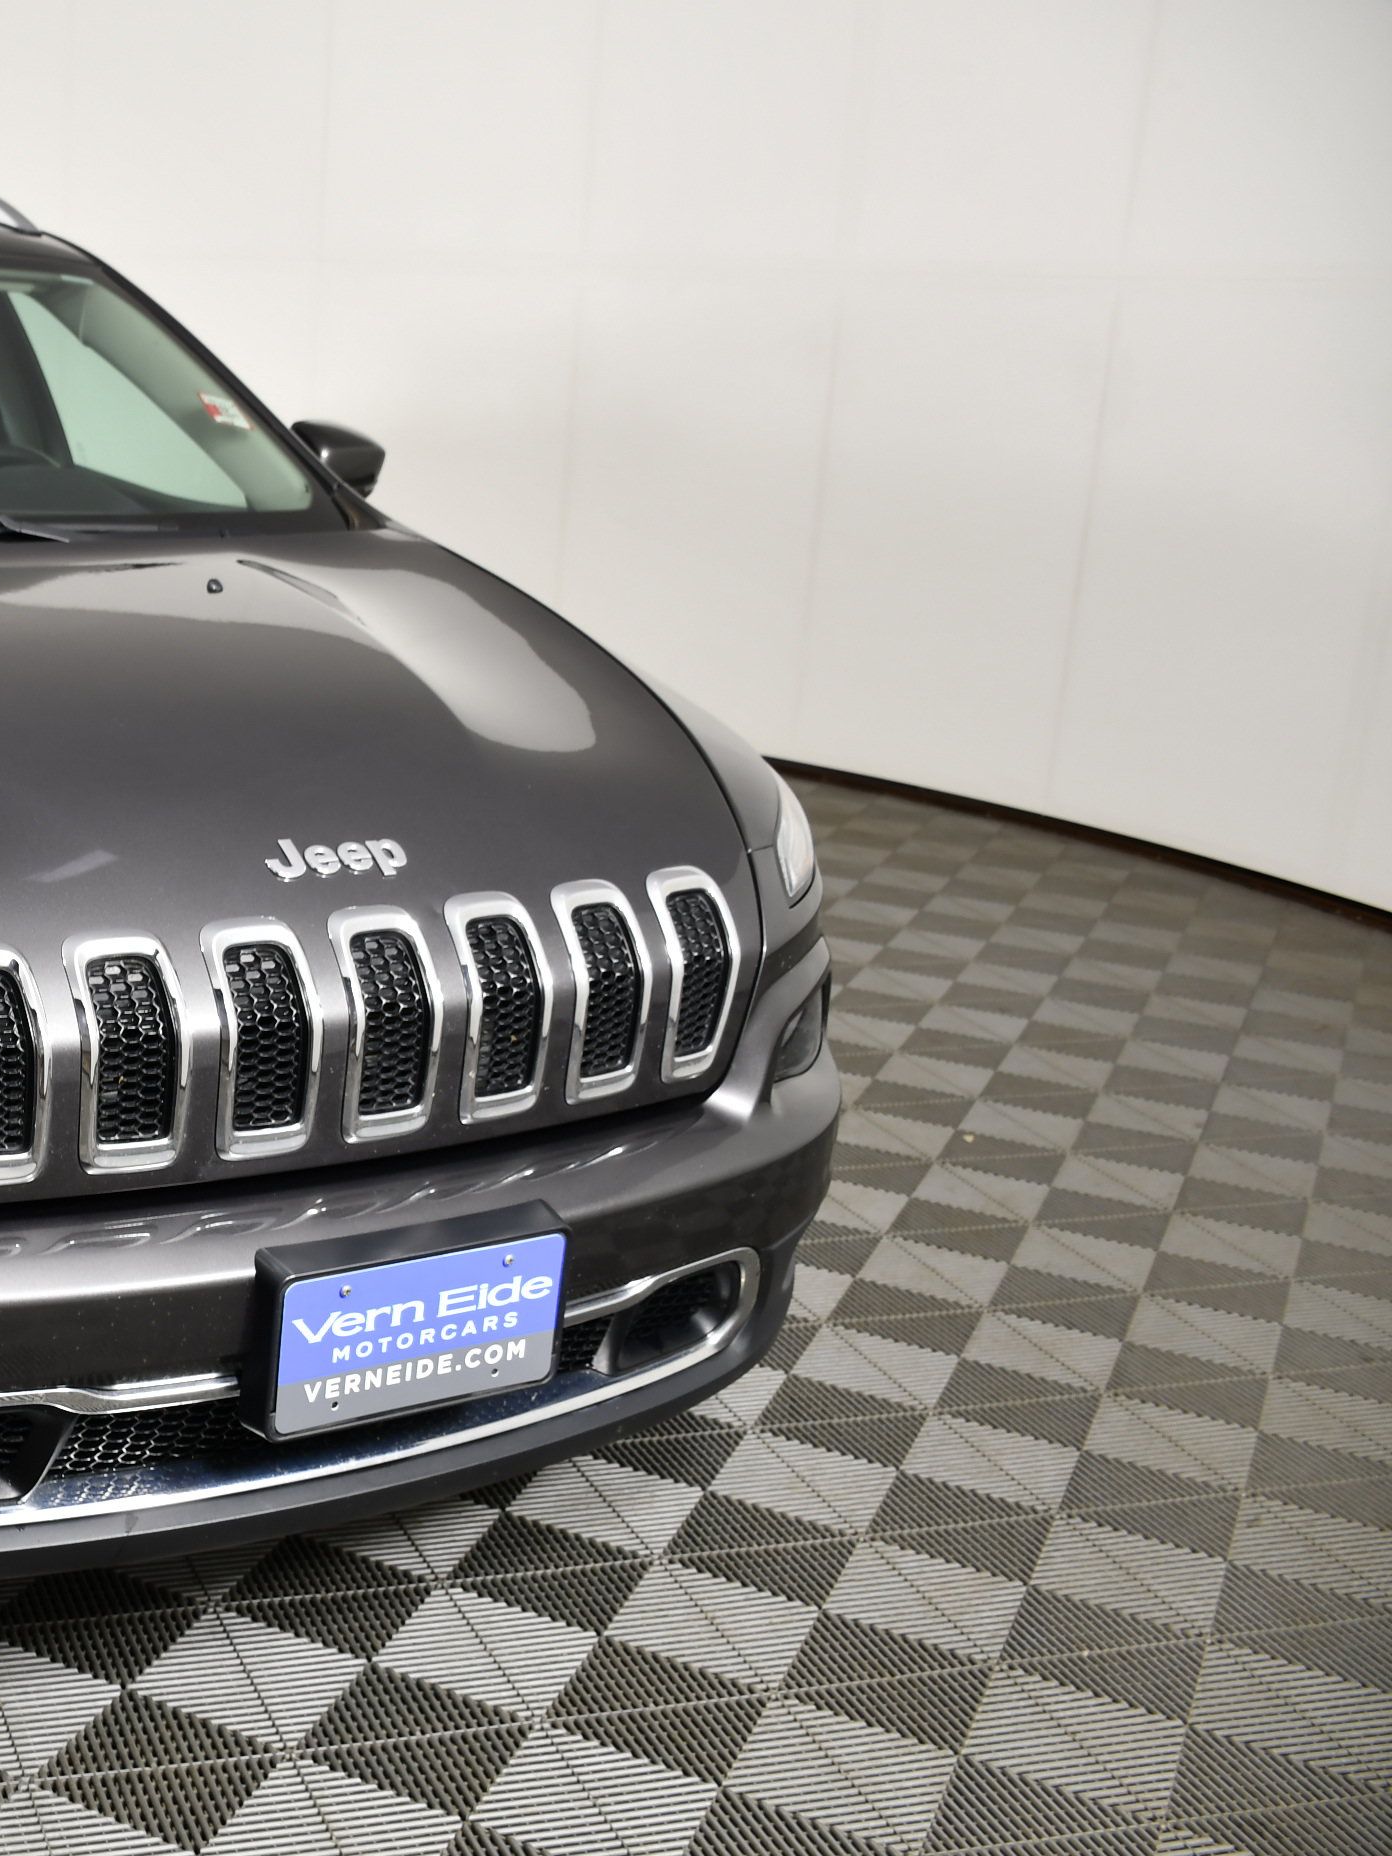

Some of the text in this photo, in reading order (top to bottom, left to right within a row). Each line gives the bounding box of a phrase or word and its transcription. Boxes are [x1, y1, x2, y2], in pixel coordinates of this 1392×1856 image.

[264, 838, 408, 880] Jeep
[291, 1275, 553, 1344] Vern Eide
[331, 1311, 519, 1364] MOTORCARS
[303, 1338, 526, 1404] VERNEIDE.COM
